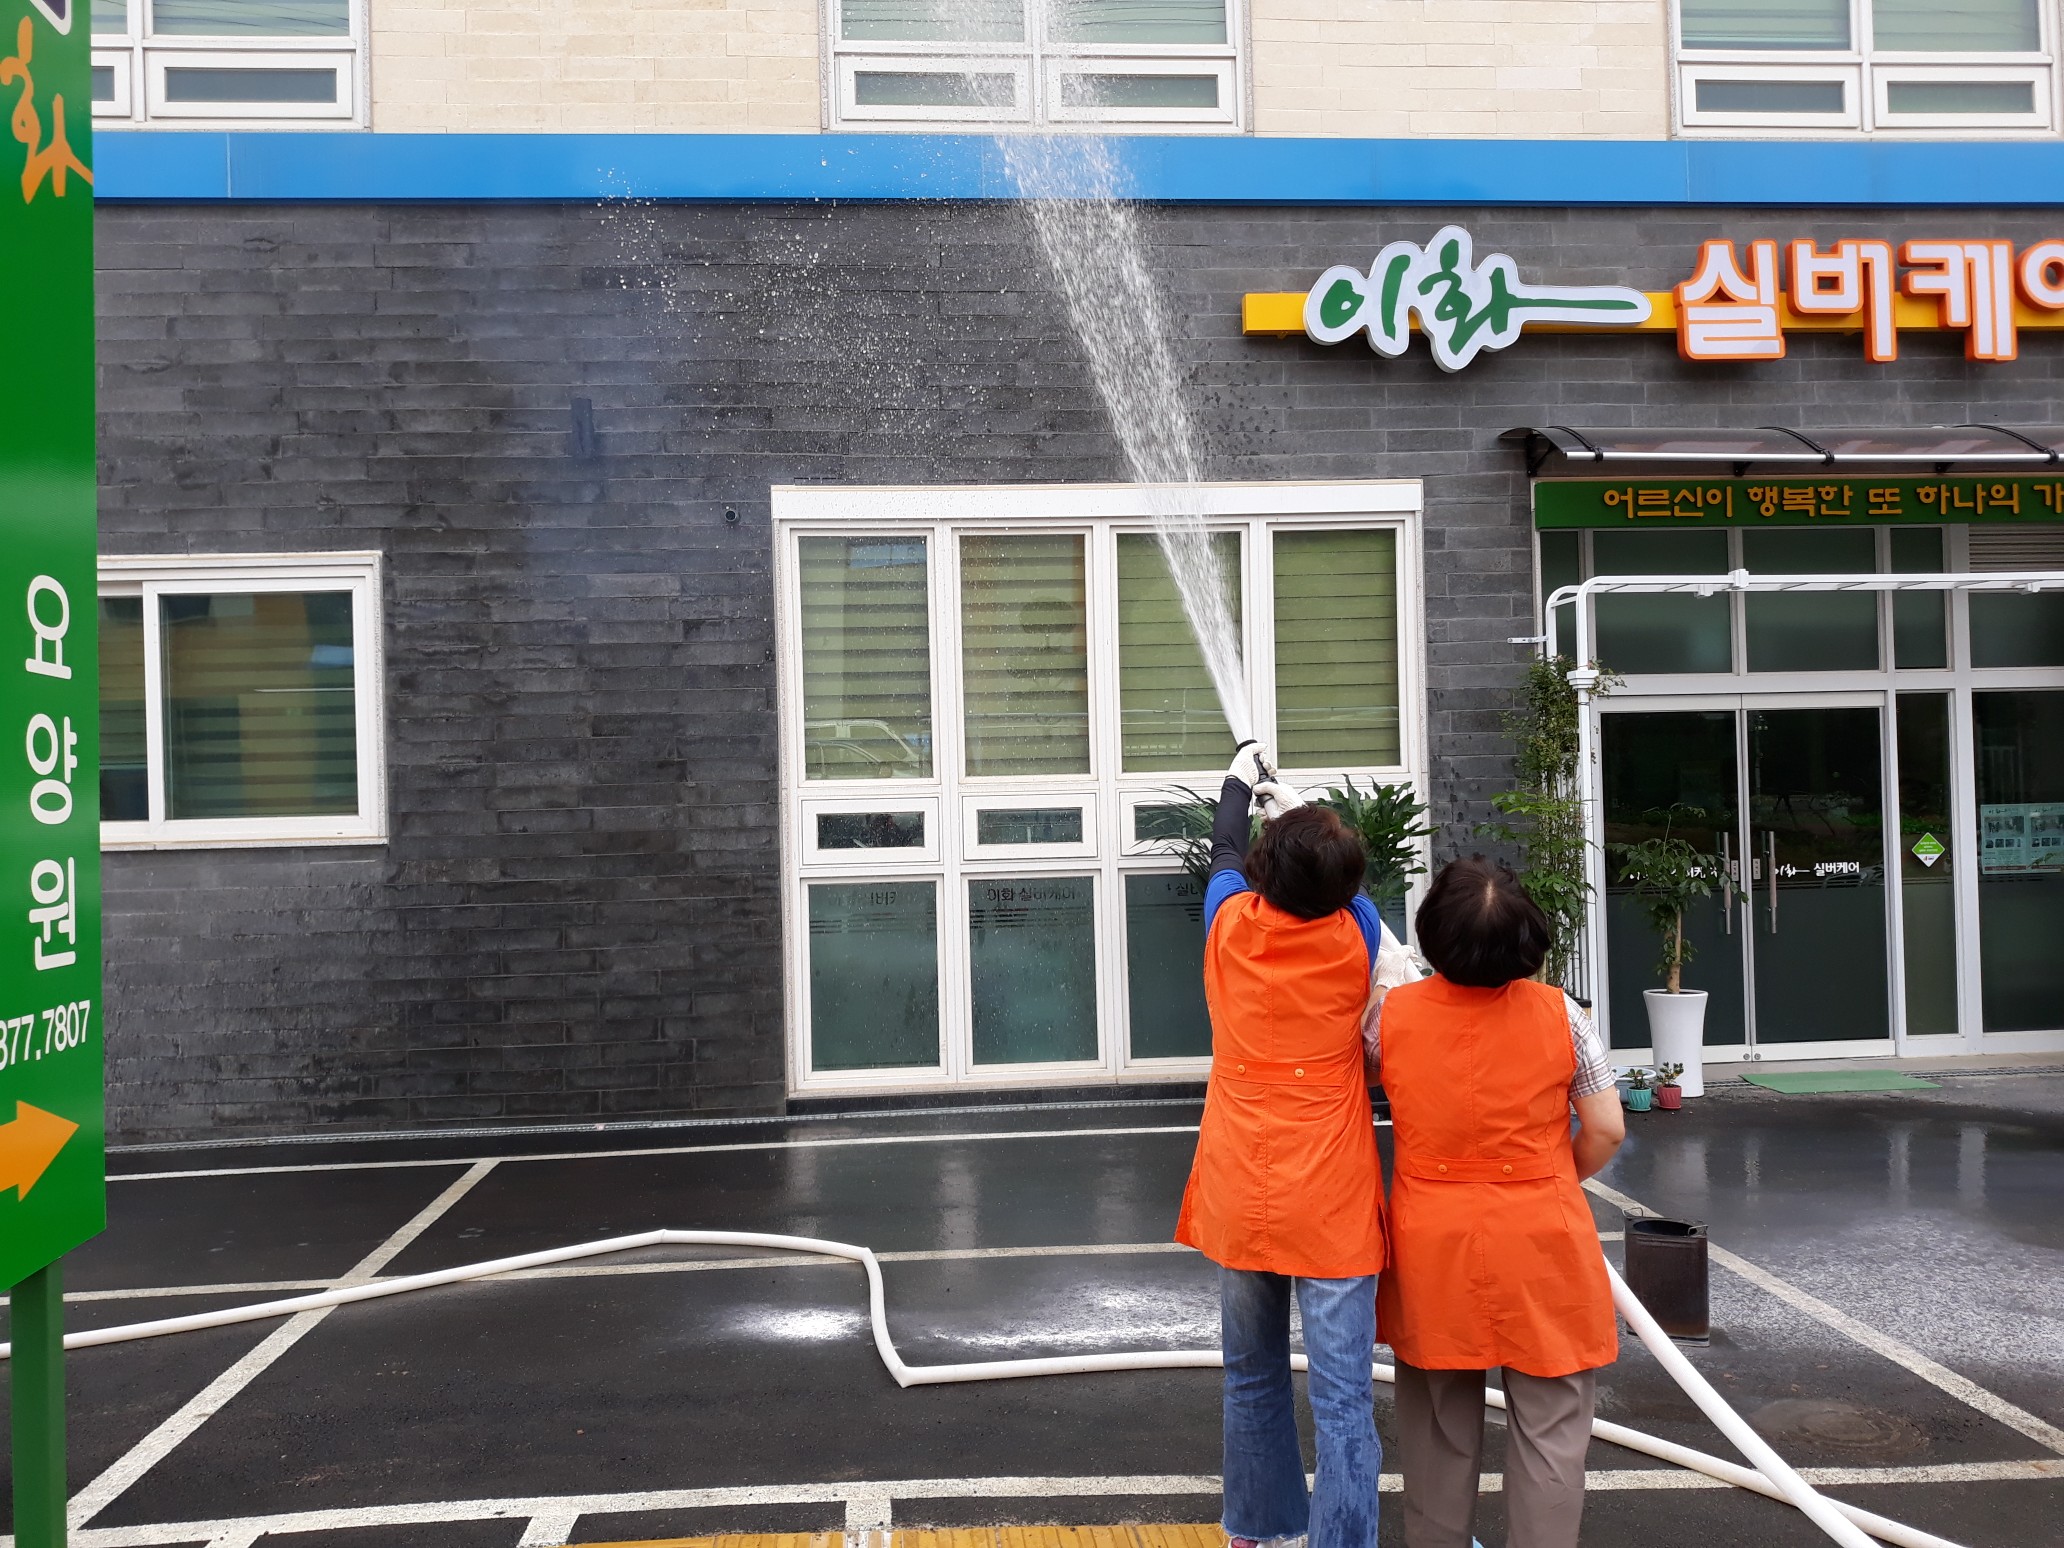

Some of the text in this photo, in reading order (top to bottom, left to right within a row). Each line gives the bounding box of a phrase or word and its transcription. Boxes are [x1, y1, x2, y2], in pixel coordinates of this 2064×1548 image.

[1308, 230, 1646, 366] 이화
[1602, 485, 1734, 519] 어르신이
[1747, 484, 1854, 517] 행복한
[1868, 487, 1903, 515] 또
[1916, 483, 2020, 515] 하나의
[25, 575, 78, 970] 요양원
[1813, 861, 1860, 877] 실버케어
[987, 887, 1015, 902] 이화
